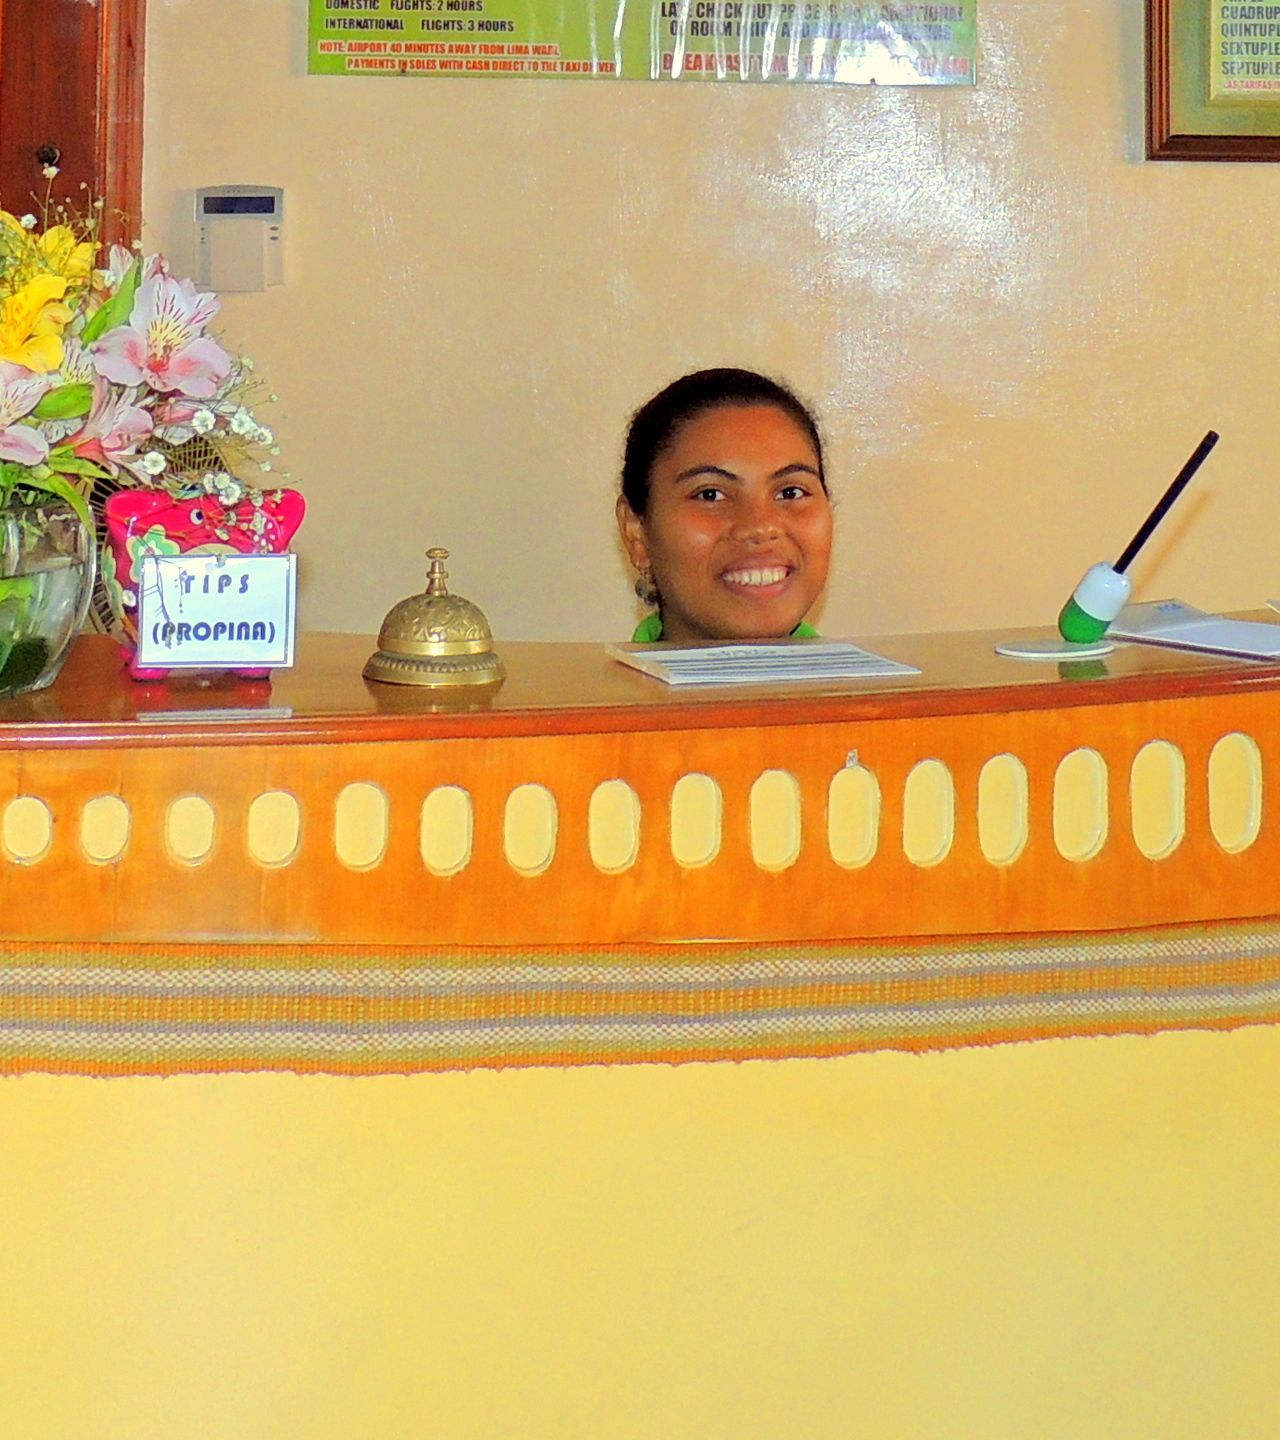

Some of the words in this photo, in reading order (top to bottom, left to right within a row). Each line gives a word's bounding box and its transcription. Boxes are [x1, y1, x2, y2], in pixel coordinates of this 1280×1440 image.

[326, 0, 379, 10] DOMESTIC
[390, 0, 435, 11] FLIGHTS:
[437, 0, 444, 11] 2
[447, 0, 483, 11] HOURS
[325, 19, 404, 30] INTERNATIONAL
[421, 20, 466, 31] FLIGHTS:
[468, 20, 475, 31] 3
[478, 20, 514, 32] HOURS
[1221, 42, 1280, 55] SEXTUPLE
[1221, 62, 1280, 75] SEPTUPLE
[152, 622, 275, 644] (PROPINA)
